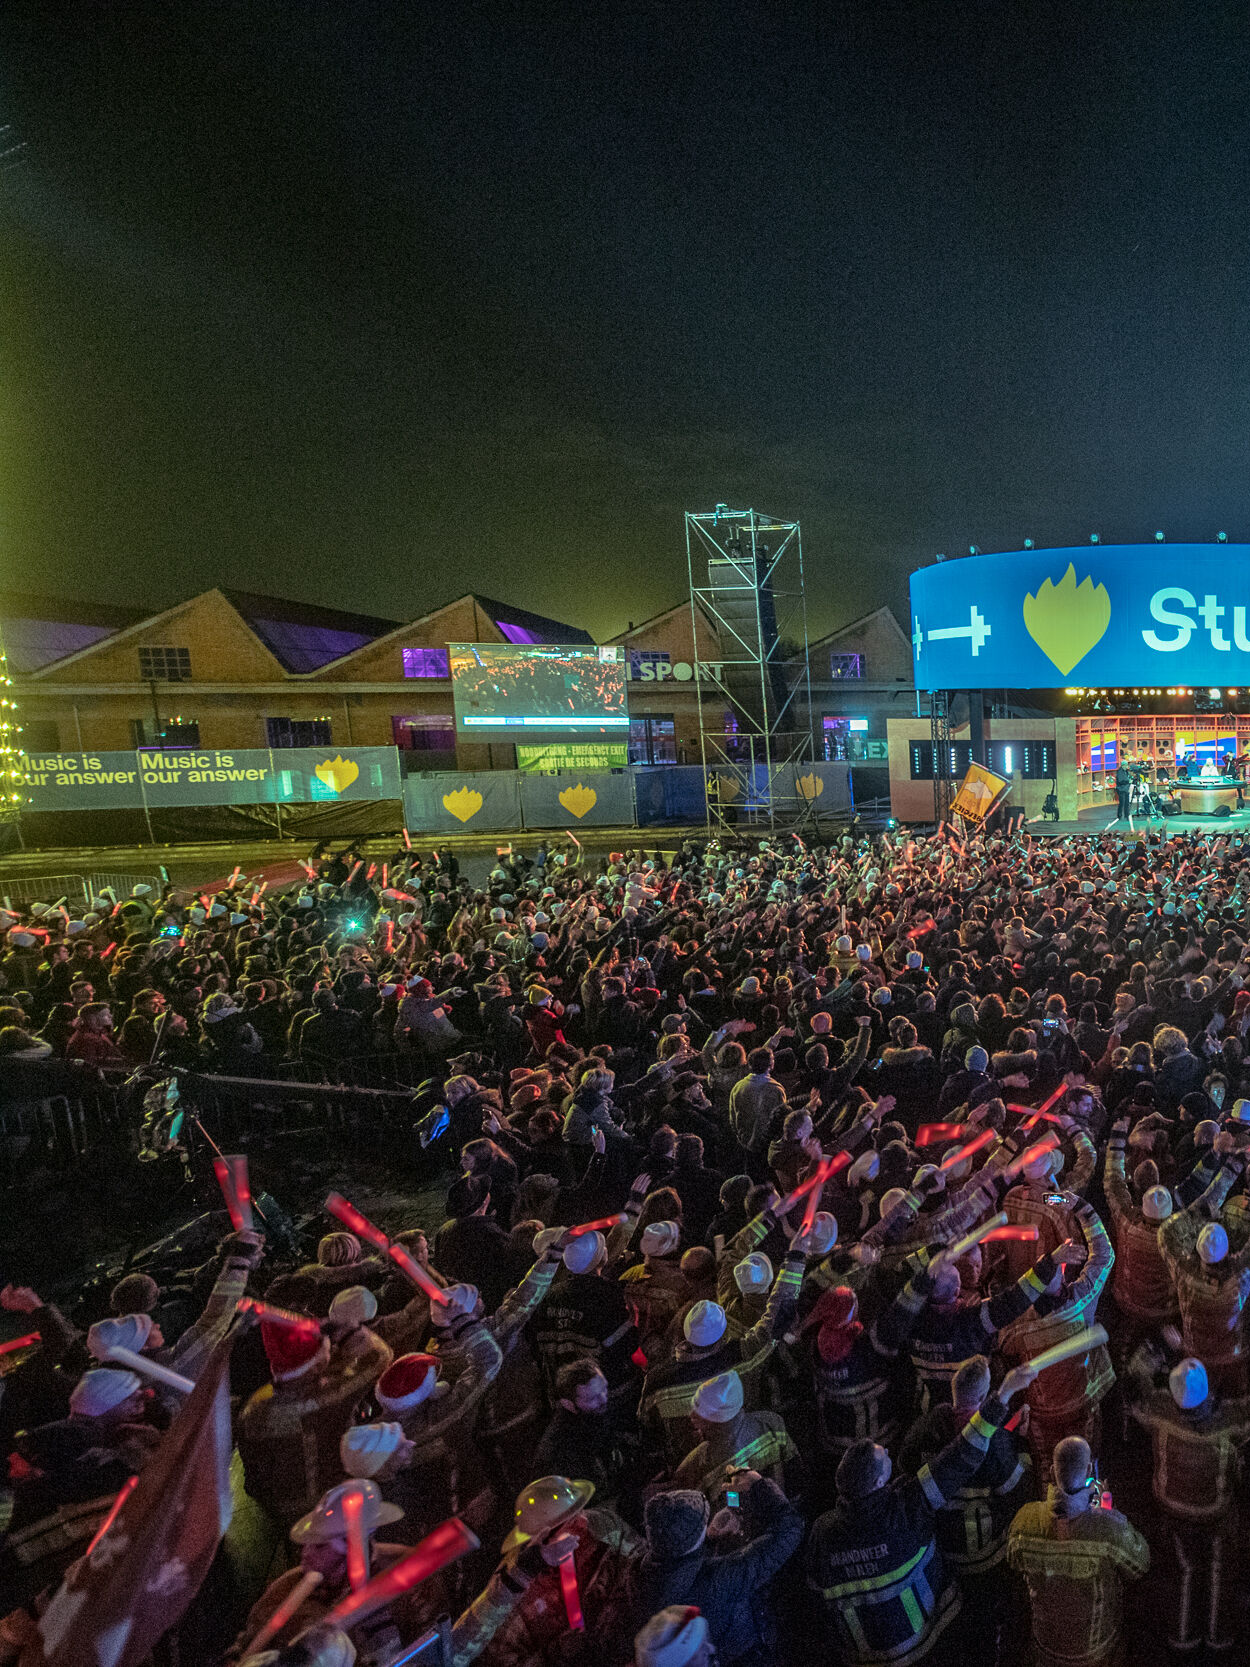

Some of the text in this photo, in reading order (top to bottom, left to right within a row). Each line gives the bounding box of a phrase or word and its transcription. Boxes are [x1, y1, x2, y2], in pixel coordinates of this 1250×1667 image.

[640, 662, 724, 681] SPORT
[572, 745, 609, 755] EMERGENCY
[610, 745, 625, 755] EXIT
[11, 754, 102, 771] Music is
[141, 752, 234, 770] Music is
[565, 757, 575, 767] DE
[576, 757, 609, 767] SECOURS
[56, 770, 136, 786] answer
[143, 768, 268, 784] our answer
